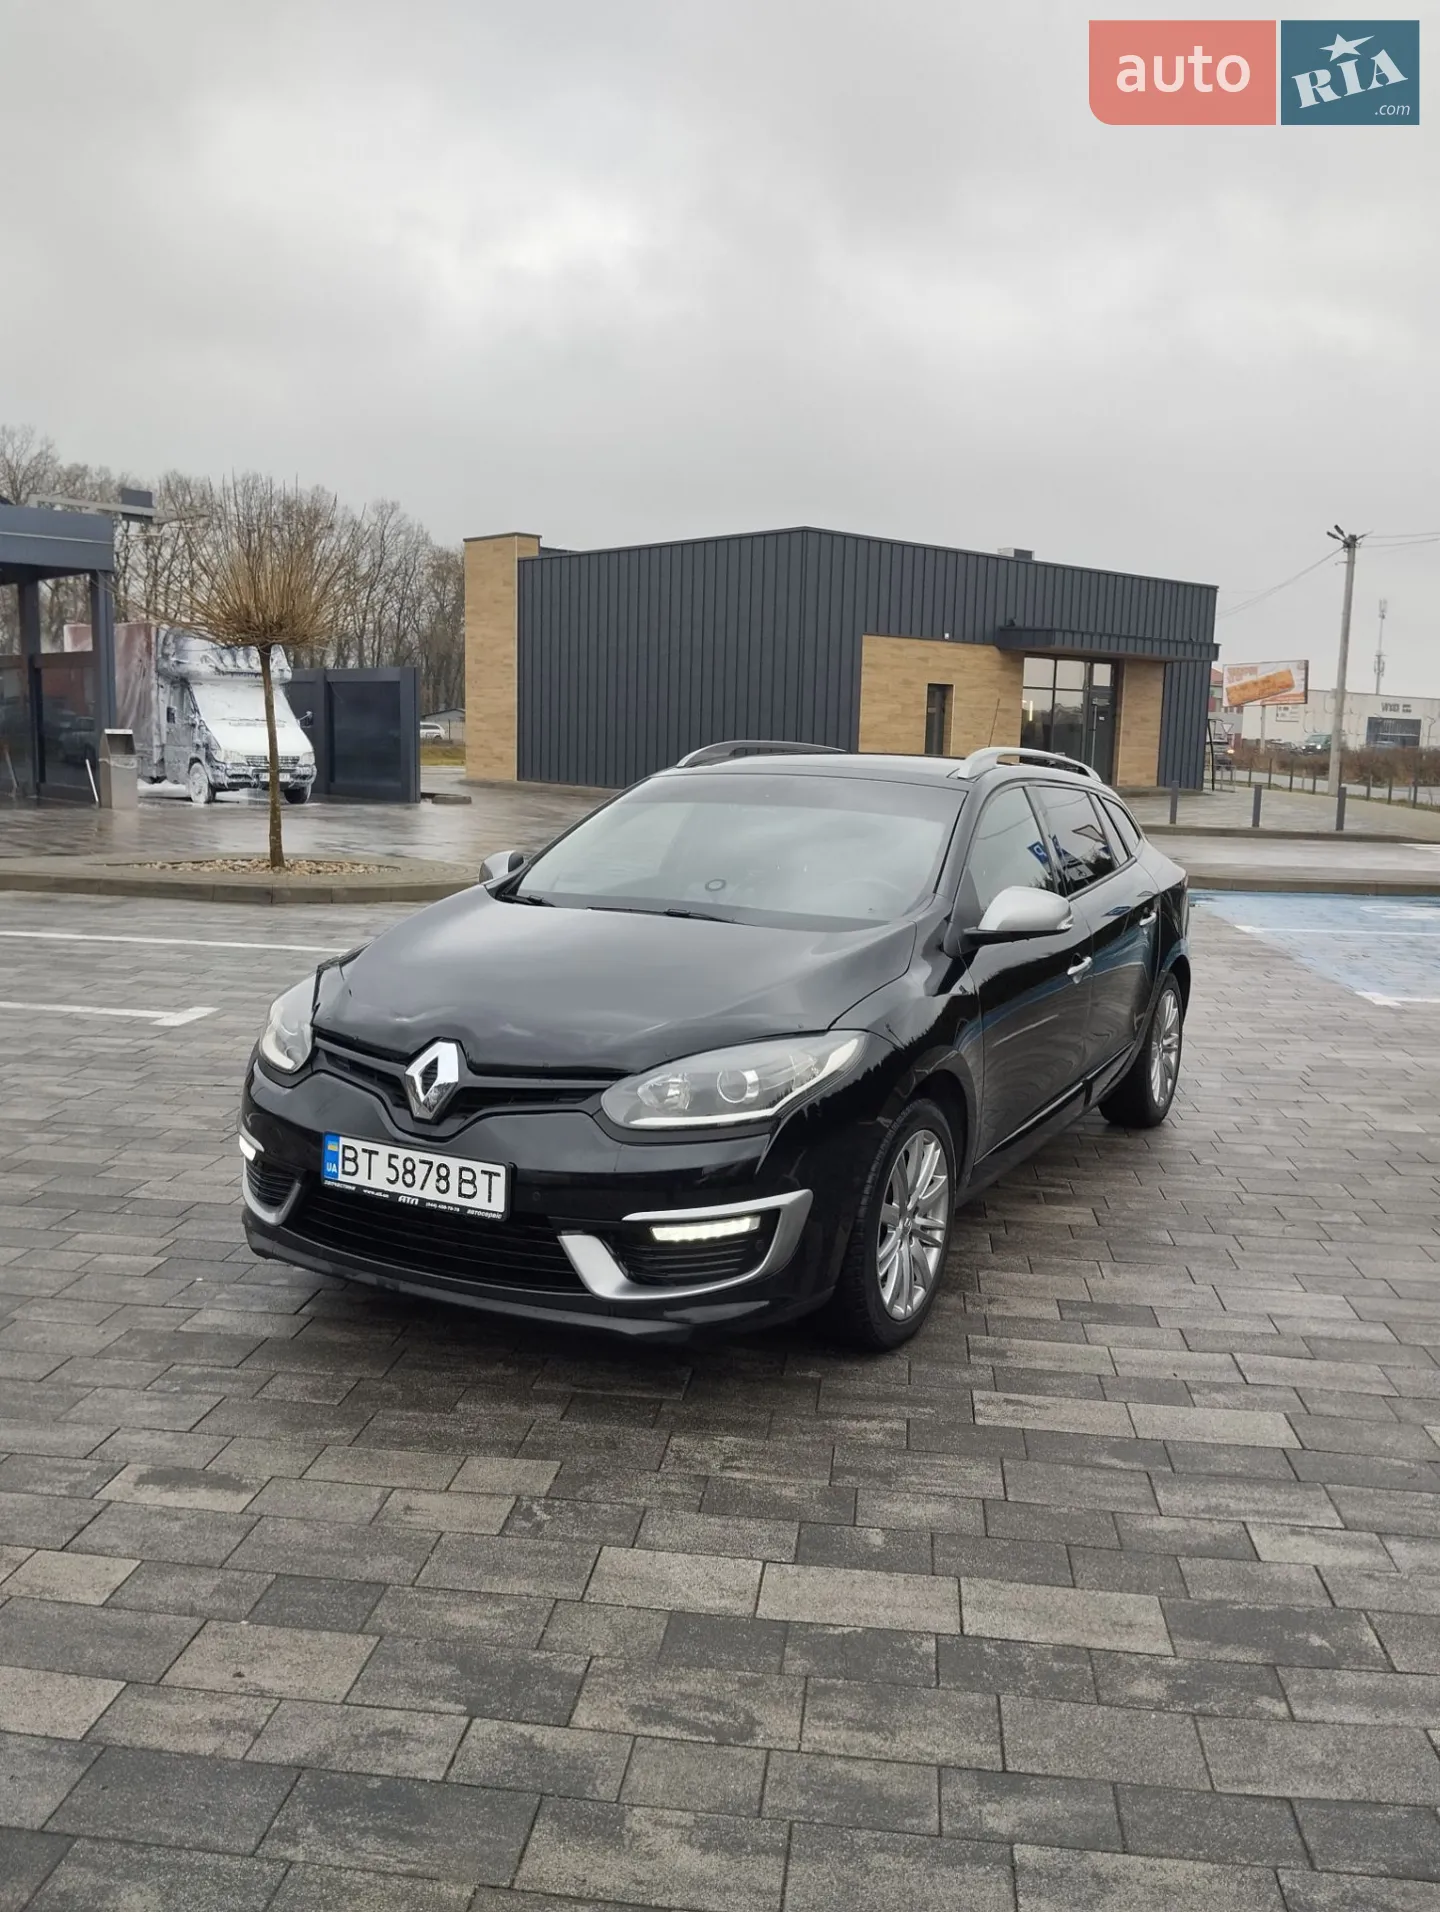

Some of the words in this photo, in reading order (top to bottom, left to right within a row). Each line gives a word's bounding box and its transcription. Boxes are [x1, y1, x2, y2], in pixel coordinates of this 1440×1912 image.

[326, 1161, 338, 1174] UA
[341, 1144, 379, 1181] BT
[385, 1153, 451, 1195] 5878
[457, 1165, 501, 1204] BT
